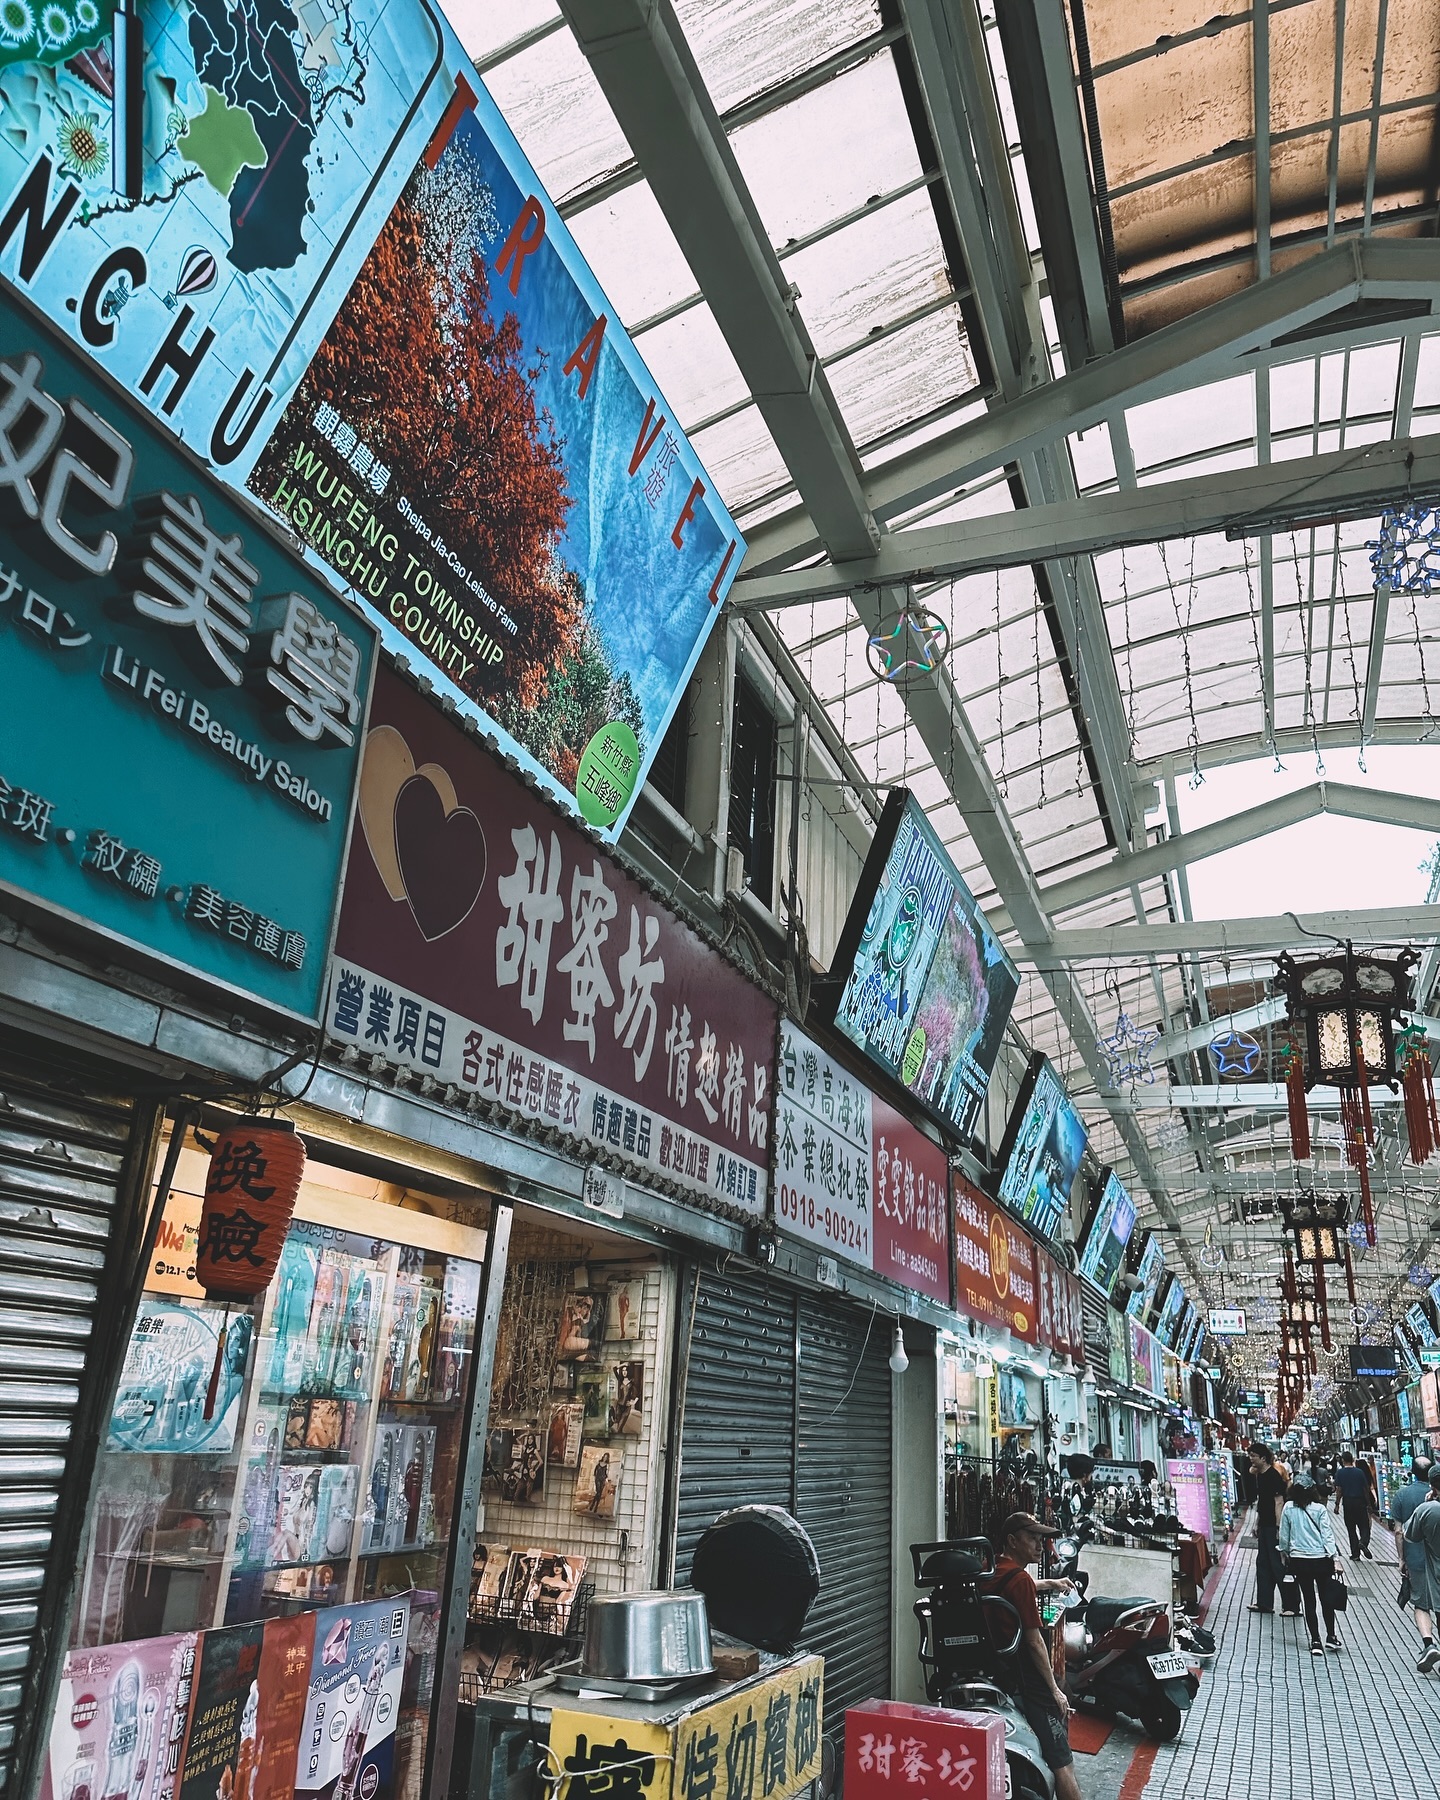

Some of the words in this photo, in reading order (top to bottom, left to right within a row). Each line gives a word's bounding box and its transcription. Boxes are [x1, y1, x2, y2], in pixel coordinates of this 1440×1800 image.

[421, 70, 738, 607] TRAVEL
[312, 400, 391, 496] 觀霧農場
[273, 477, 386, 597] HSINCHU
[389, 591, 475, 682] COUNTY
[294, 441, 400, 562] WUFENG
[404, 556, 505, 667] TOWNSHIP
[396, 496, 432, 541] Sheipa
[430, 534, 466, 575] Jia-Cao
[464, 568, 500, 611] Leisure
[496, 604, 519, 636] Farm
[112, 648, 140, 688] Li
[143, 667, 186, 719] Fei
[188, 700, 273, 781] Beauty
[274, 761, 333, 822] Salon
[496, 821, 665, 1083] 甜蜜坊
[334, 968, 447, 1068] 營業項目
[461, 1029, 582, 1128] 各式性感睡衣
[592, 1092, 652, 1160] 情趣禮品
[664, 1003, 769, 1150] 情趣精品
[784, 1034, 868, 1146] 台灣高海拔
[659, 1124, 710, 1184] 歡迎加盟
[715, 1153, 758, 1205] 外銷訂單
[780, 1108, 870, 1215] 茶葉總批發
[780, 1183, 869, 1256] 0918-909241
[857, 1732, 978, 1791] 甜蜜坊
